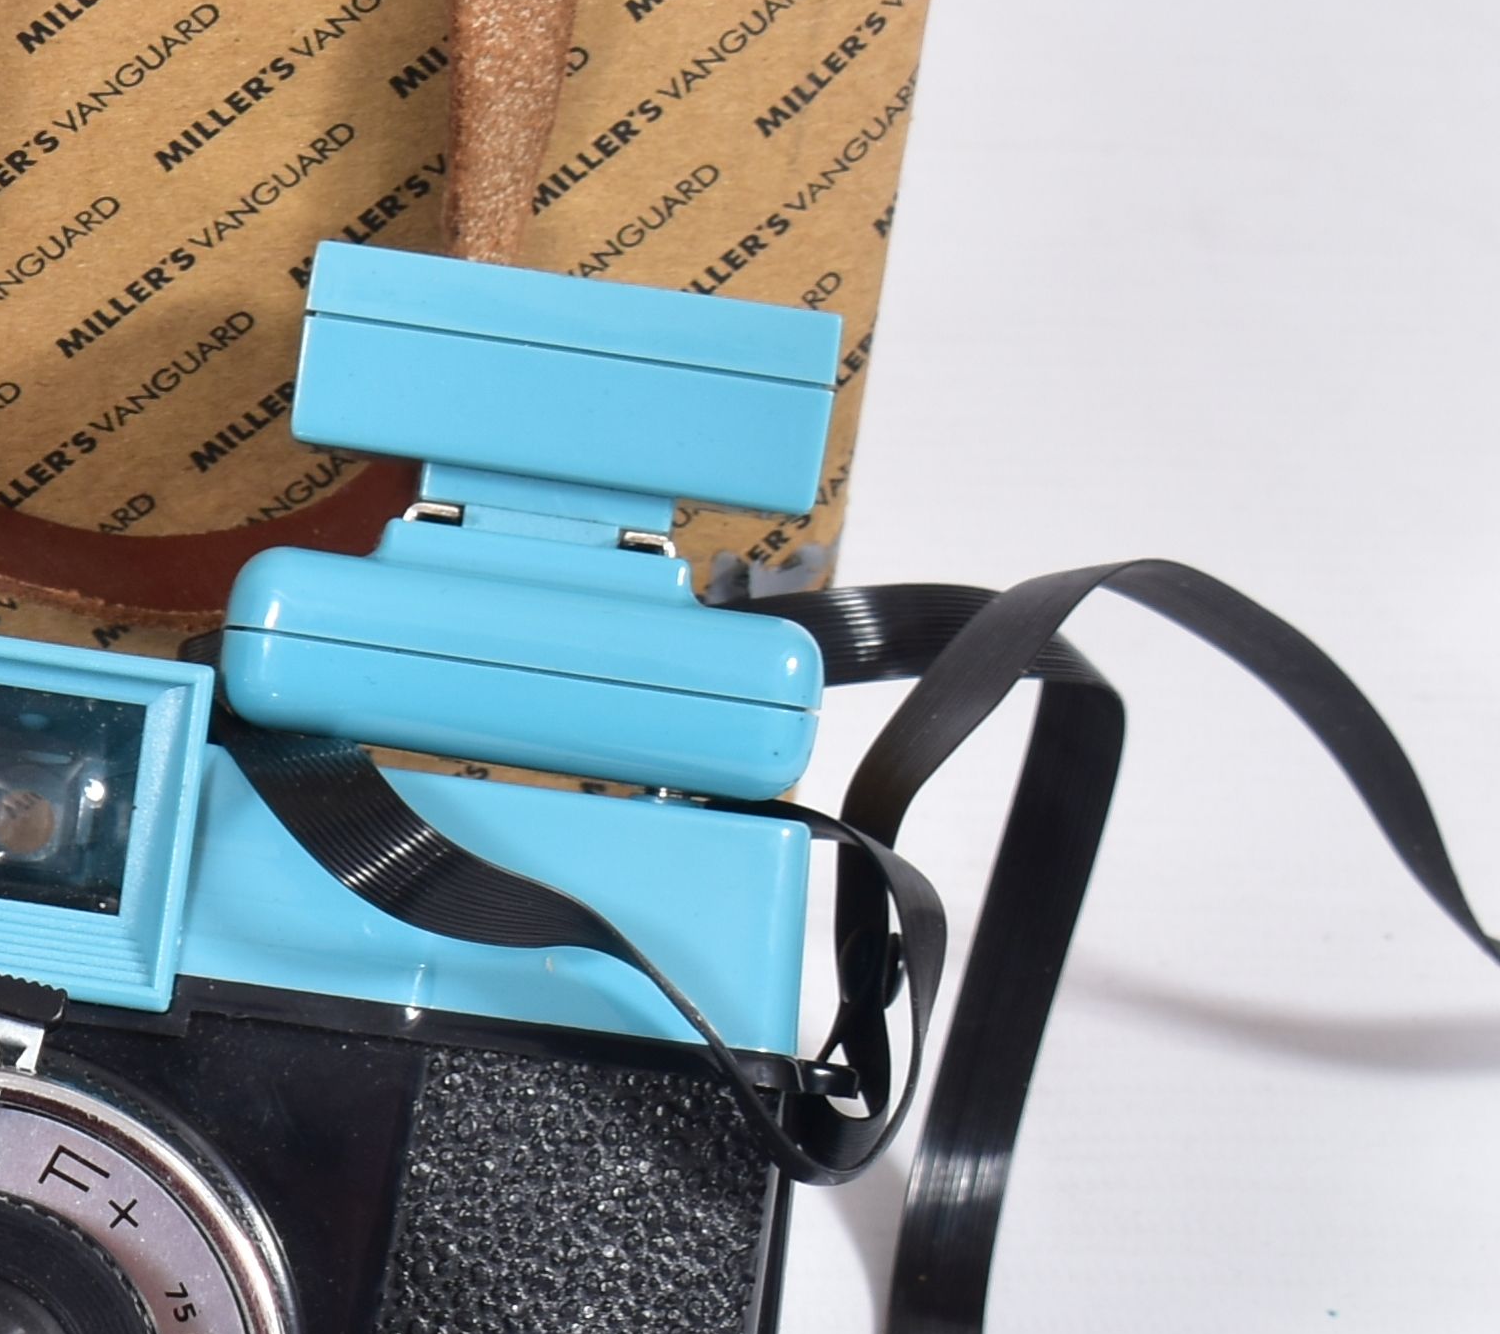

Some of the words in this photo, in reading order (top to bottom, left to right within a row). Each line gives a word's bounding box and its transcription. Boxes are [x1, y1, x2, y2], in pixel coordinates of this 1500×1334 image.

[52, 3, 220, 132] VANGUARD
[55, 247, 196, 359] MILLER'S
[188, 123, 355, 248] VANGUARD
[38, 1143, 140, 1231] F+
[163, 1281, 198, 1324] 75
